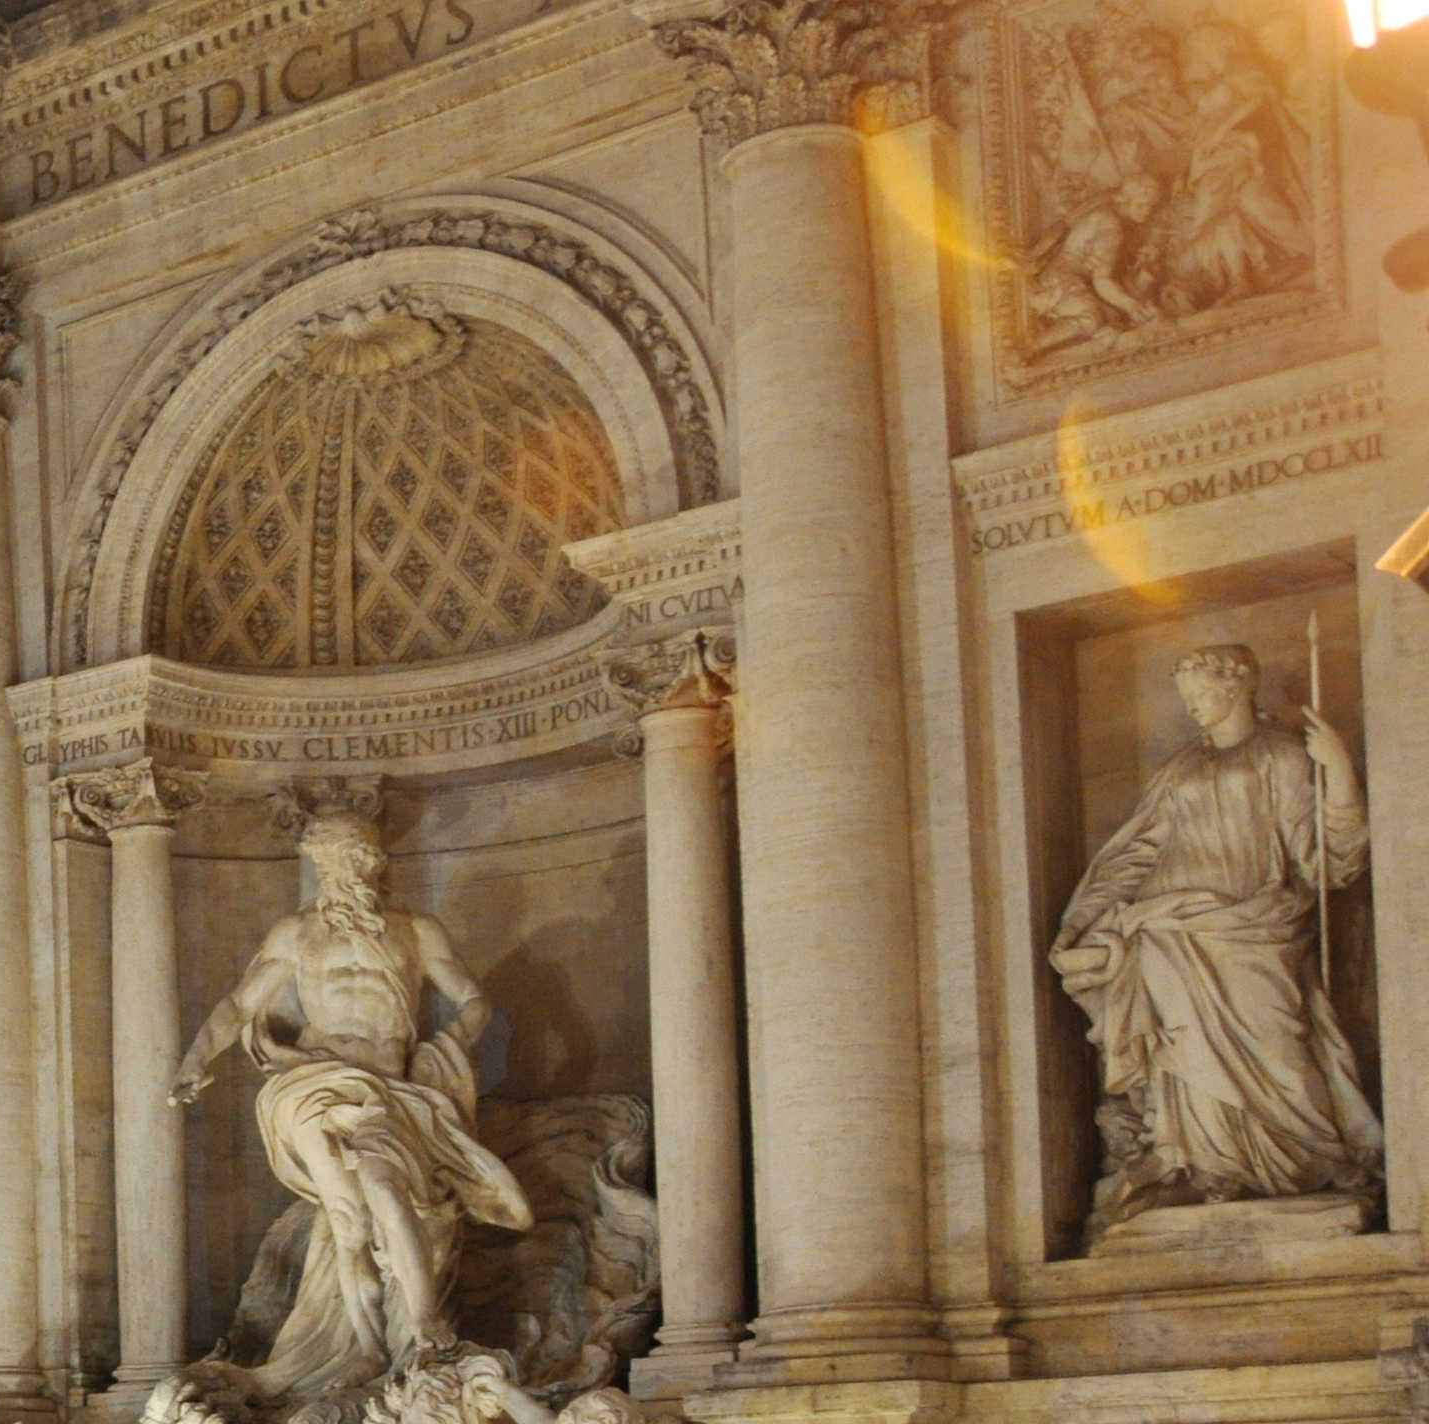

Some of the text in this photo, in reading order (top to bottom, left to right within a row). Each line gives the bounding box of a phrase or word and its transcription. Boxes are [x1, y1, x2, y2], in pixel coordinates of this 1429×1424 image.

[29, 0, 476, 206] BENEDICTVS
[970, 502, 1107, 556] SOLVTVM
[211, 735, 284, 760] IVSSV
